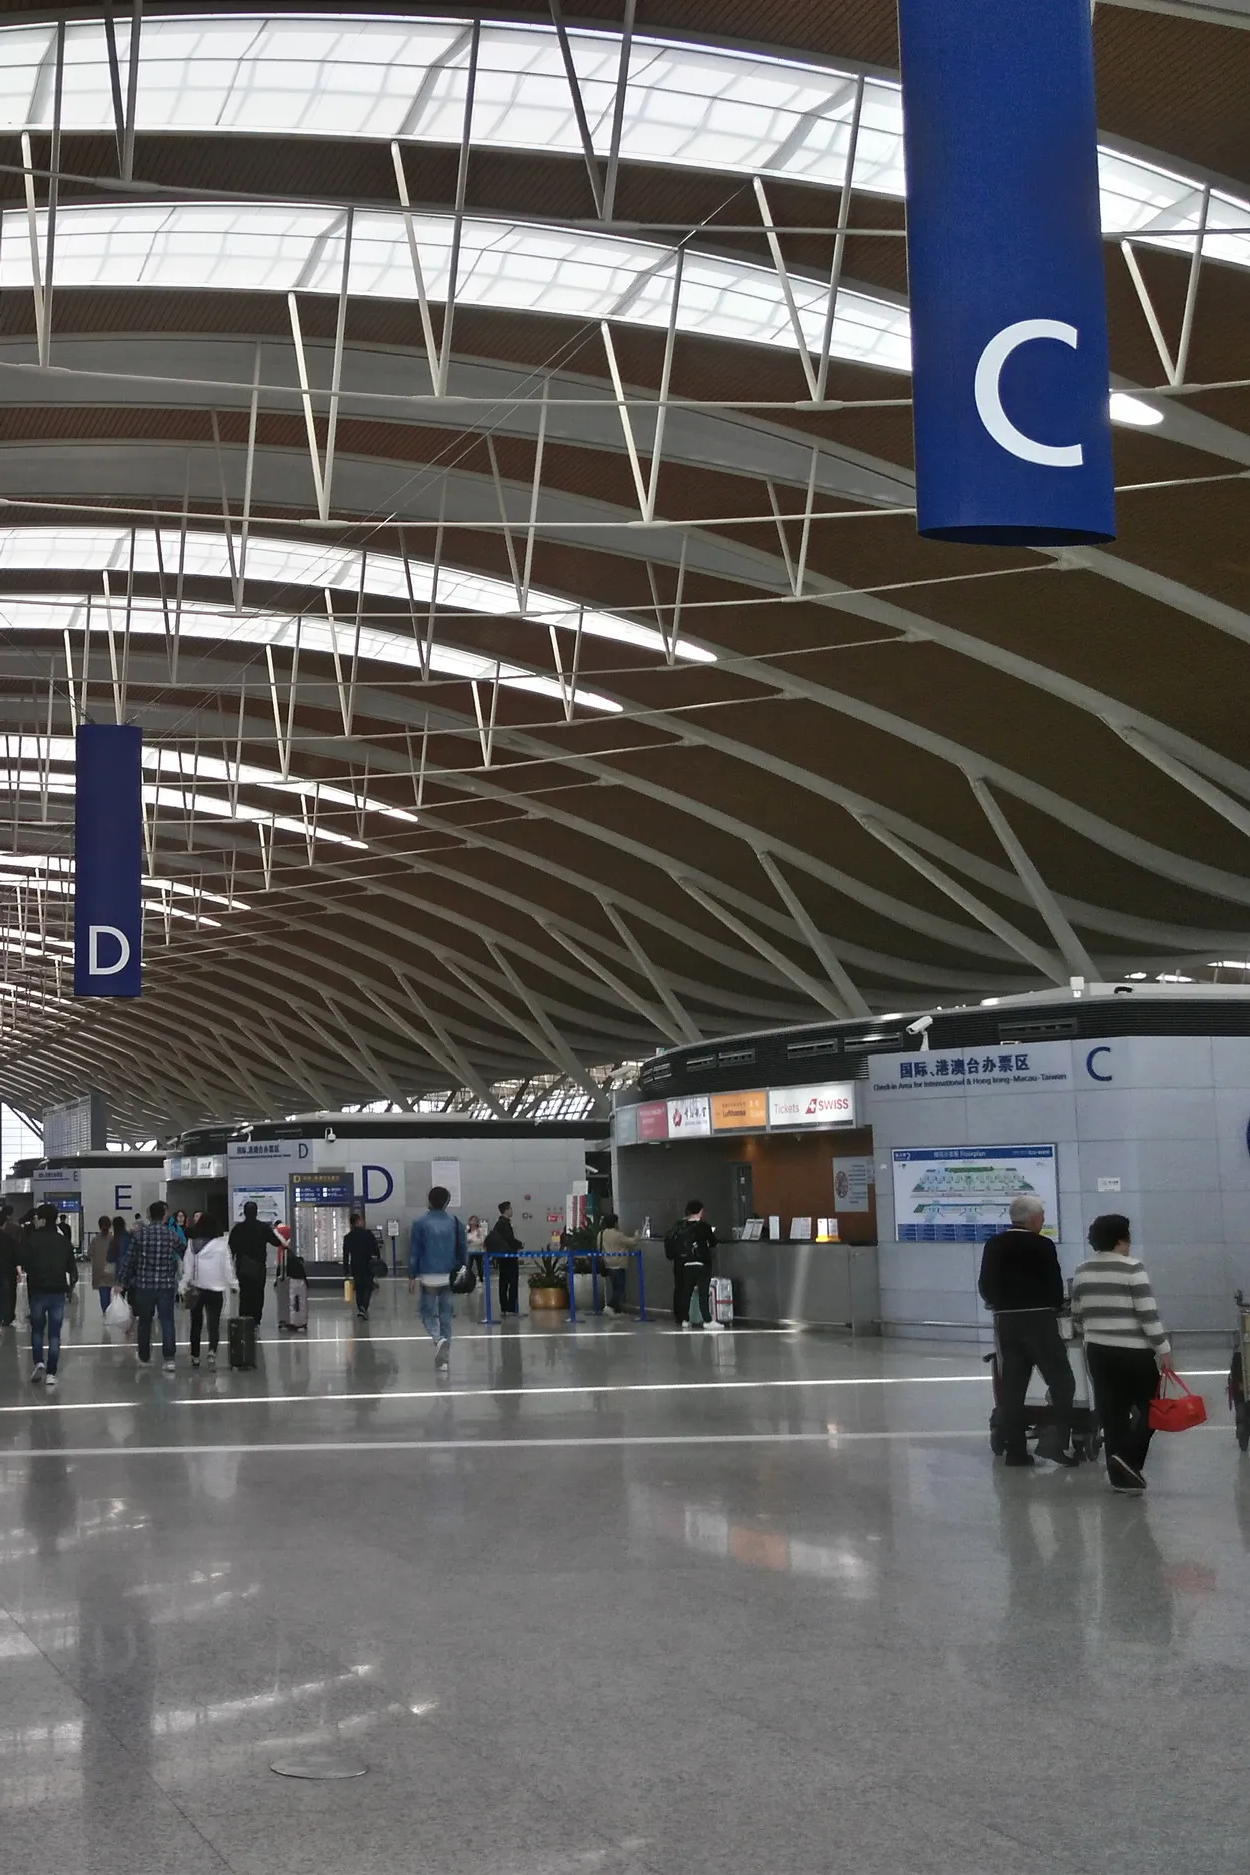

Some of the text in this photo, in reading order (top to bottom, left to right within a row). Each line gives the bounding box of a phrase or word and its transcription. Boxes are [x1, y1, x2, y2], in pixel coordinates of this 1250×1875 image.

[975, 318, 1084, 468] C
[88, 925, 131, 976] D
[899, 1053, 1030, 1079] 国际、港澳台办票区
[1086, 1046, 1113, 1082] C
[923, 1078, 965, 1088] International
[972, 1077, 991, 1087] Hong
[774, 1103, 800, 1115] Tickets
[818, 1098, 849, 1111] SWISS
[298, 1143, 309, 1159] D
[73, 1171, 79, 1182] E
[362, 1165, 394, 1204] D
[115, 1185, 133, 1211] E
